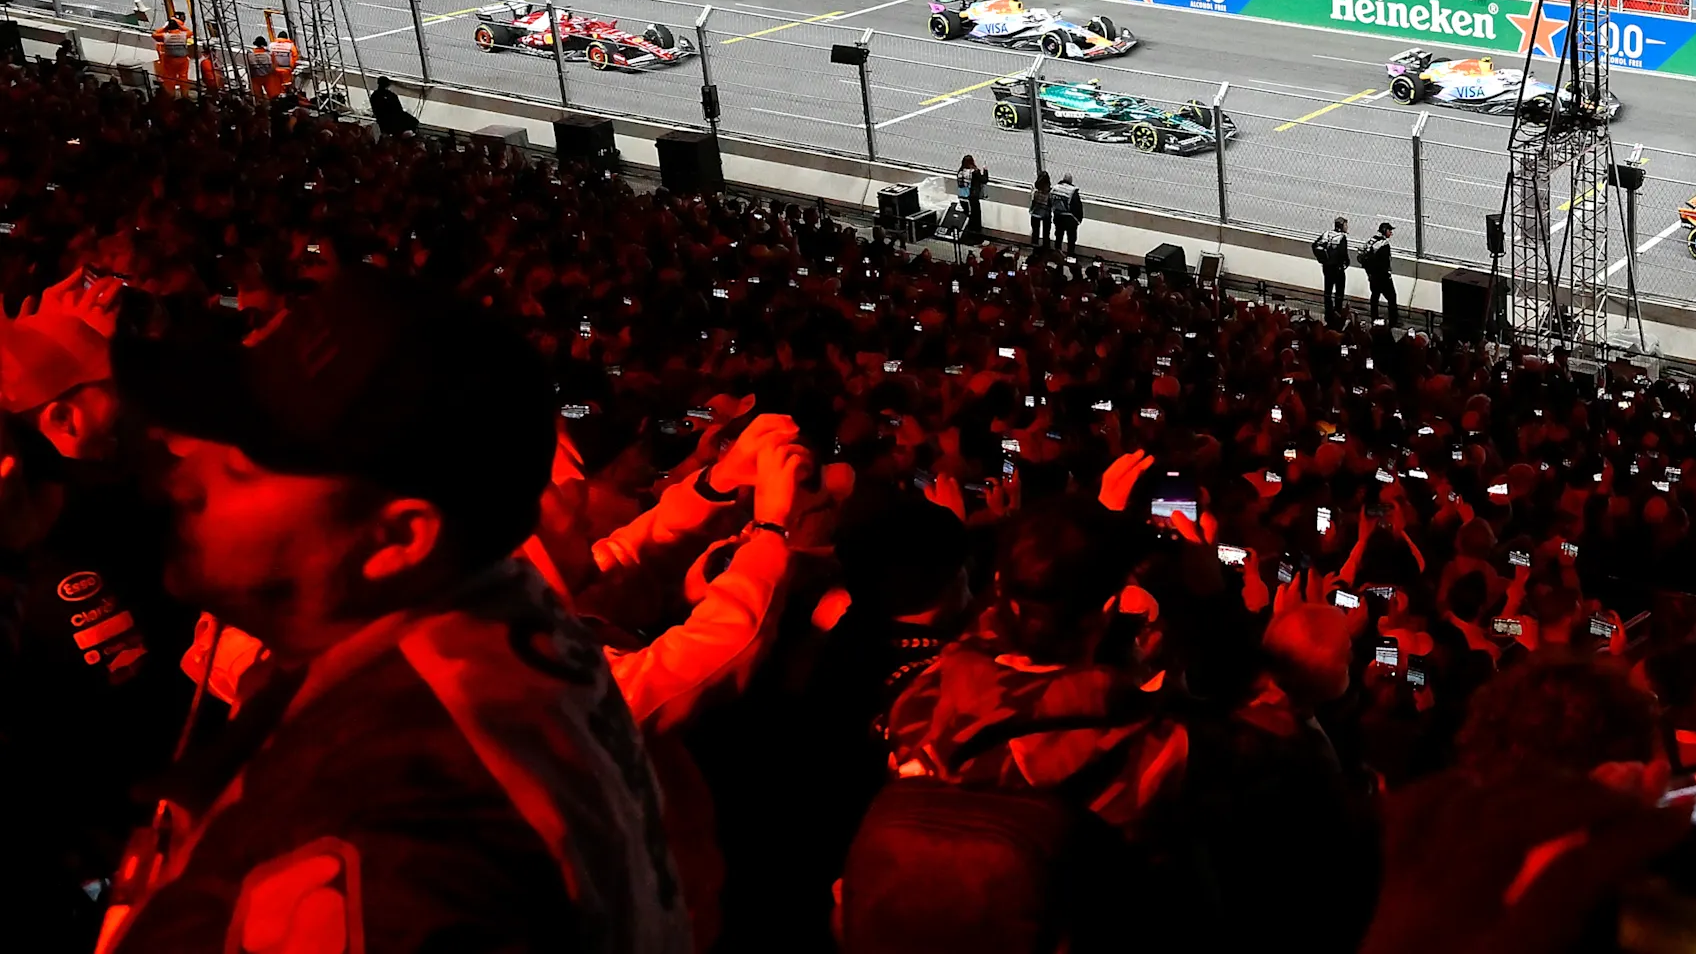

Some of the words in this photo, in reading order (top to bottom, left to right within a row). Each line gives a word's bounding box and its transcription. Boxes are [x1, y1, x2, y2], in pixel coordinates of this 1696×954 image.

[1190, 0, 1213, 11] ALCOHOL
[1214, 2, 1227, 12] FREE
[985, 22, 1009, 34] VISA
[1629, 57, 1643, 68] FREE
[1456, 85, 1486, 99] VISA
